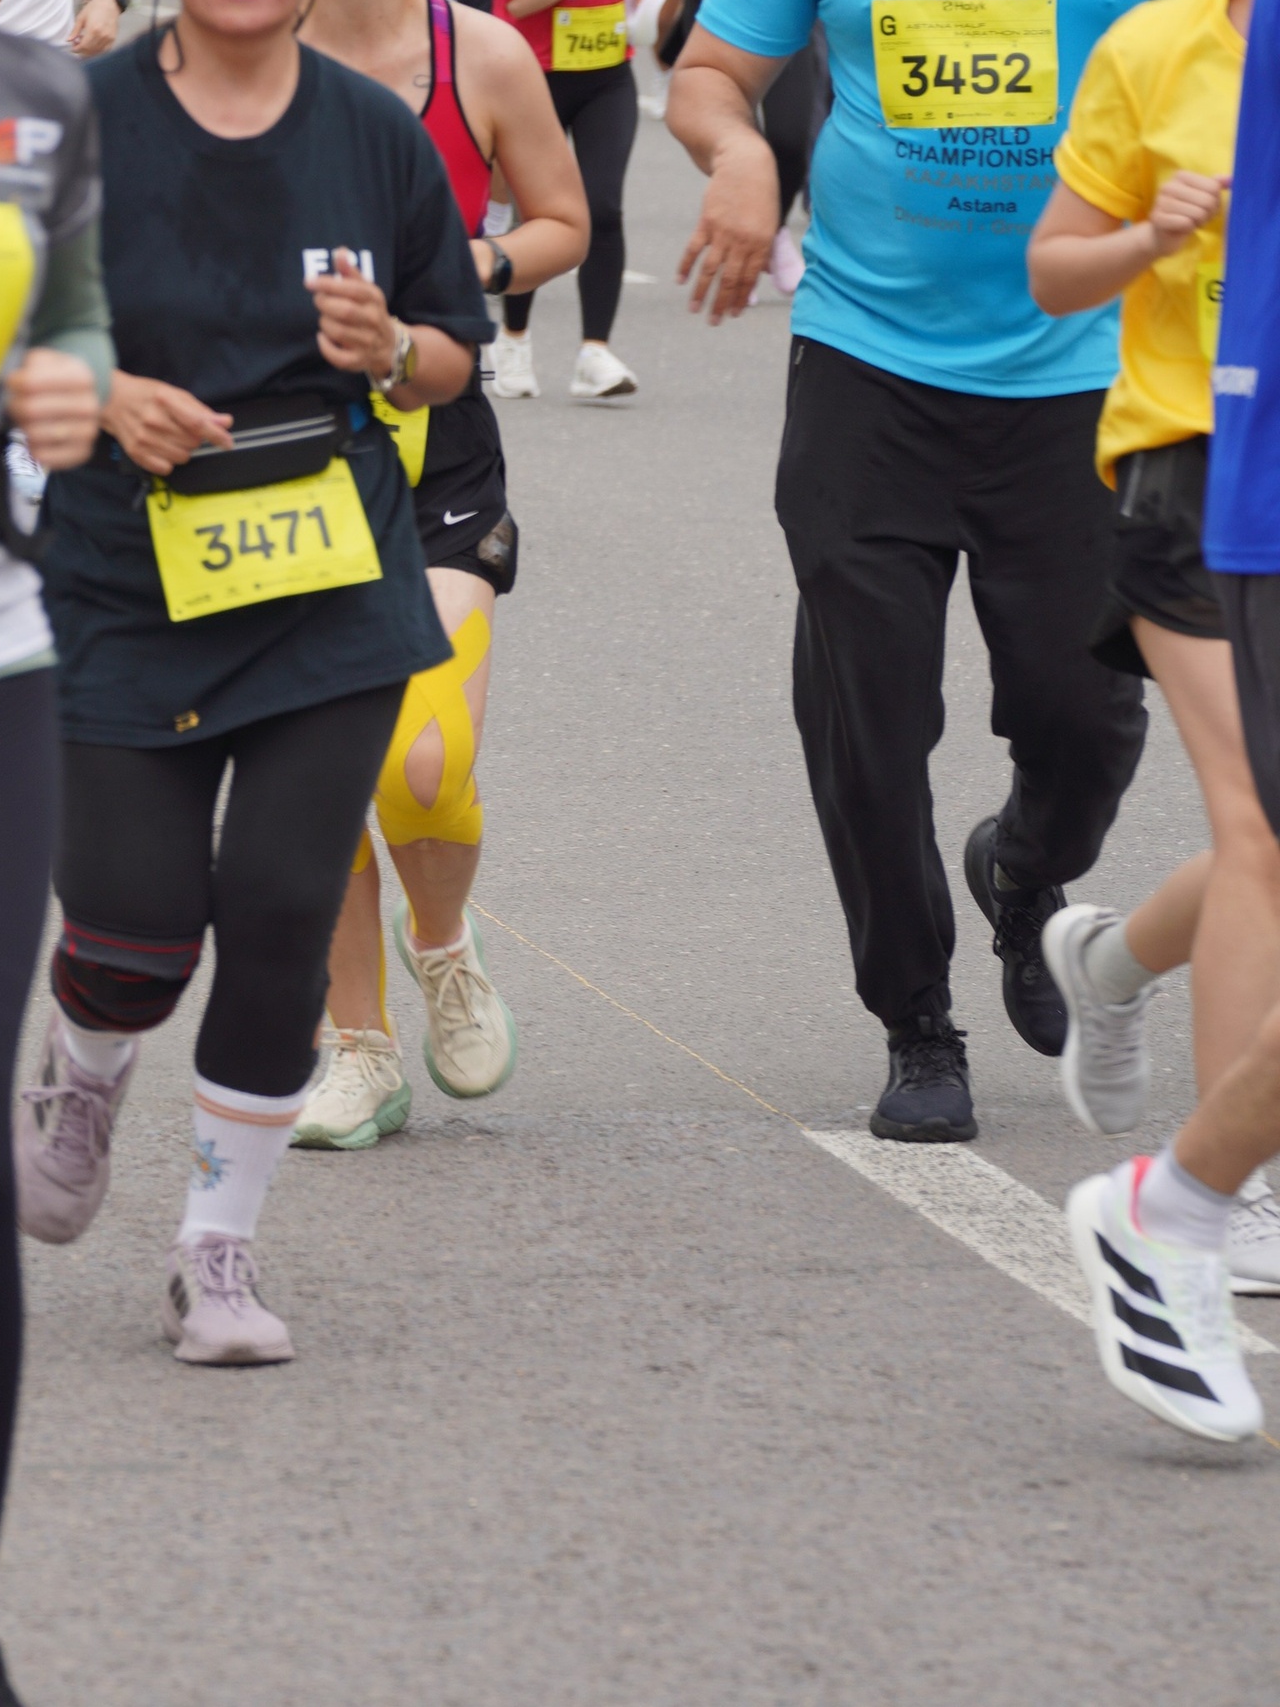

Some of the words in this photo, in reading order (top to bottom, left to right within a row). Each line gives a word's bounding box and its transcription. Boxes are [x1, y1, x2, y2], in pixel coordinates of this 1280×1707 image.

[879, 15, 897, 37] G
[953, 29, 1021, 37] MARATHON
[901, 52, 1033, 98] 3452
[939, 126, 1031, 146] WORLD
[947, 197, 1018, 214] Astana
[893, 205, 962, 233] Division
[195, 505, 333, 572] 3471
